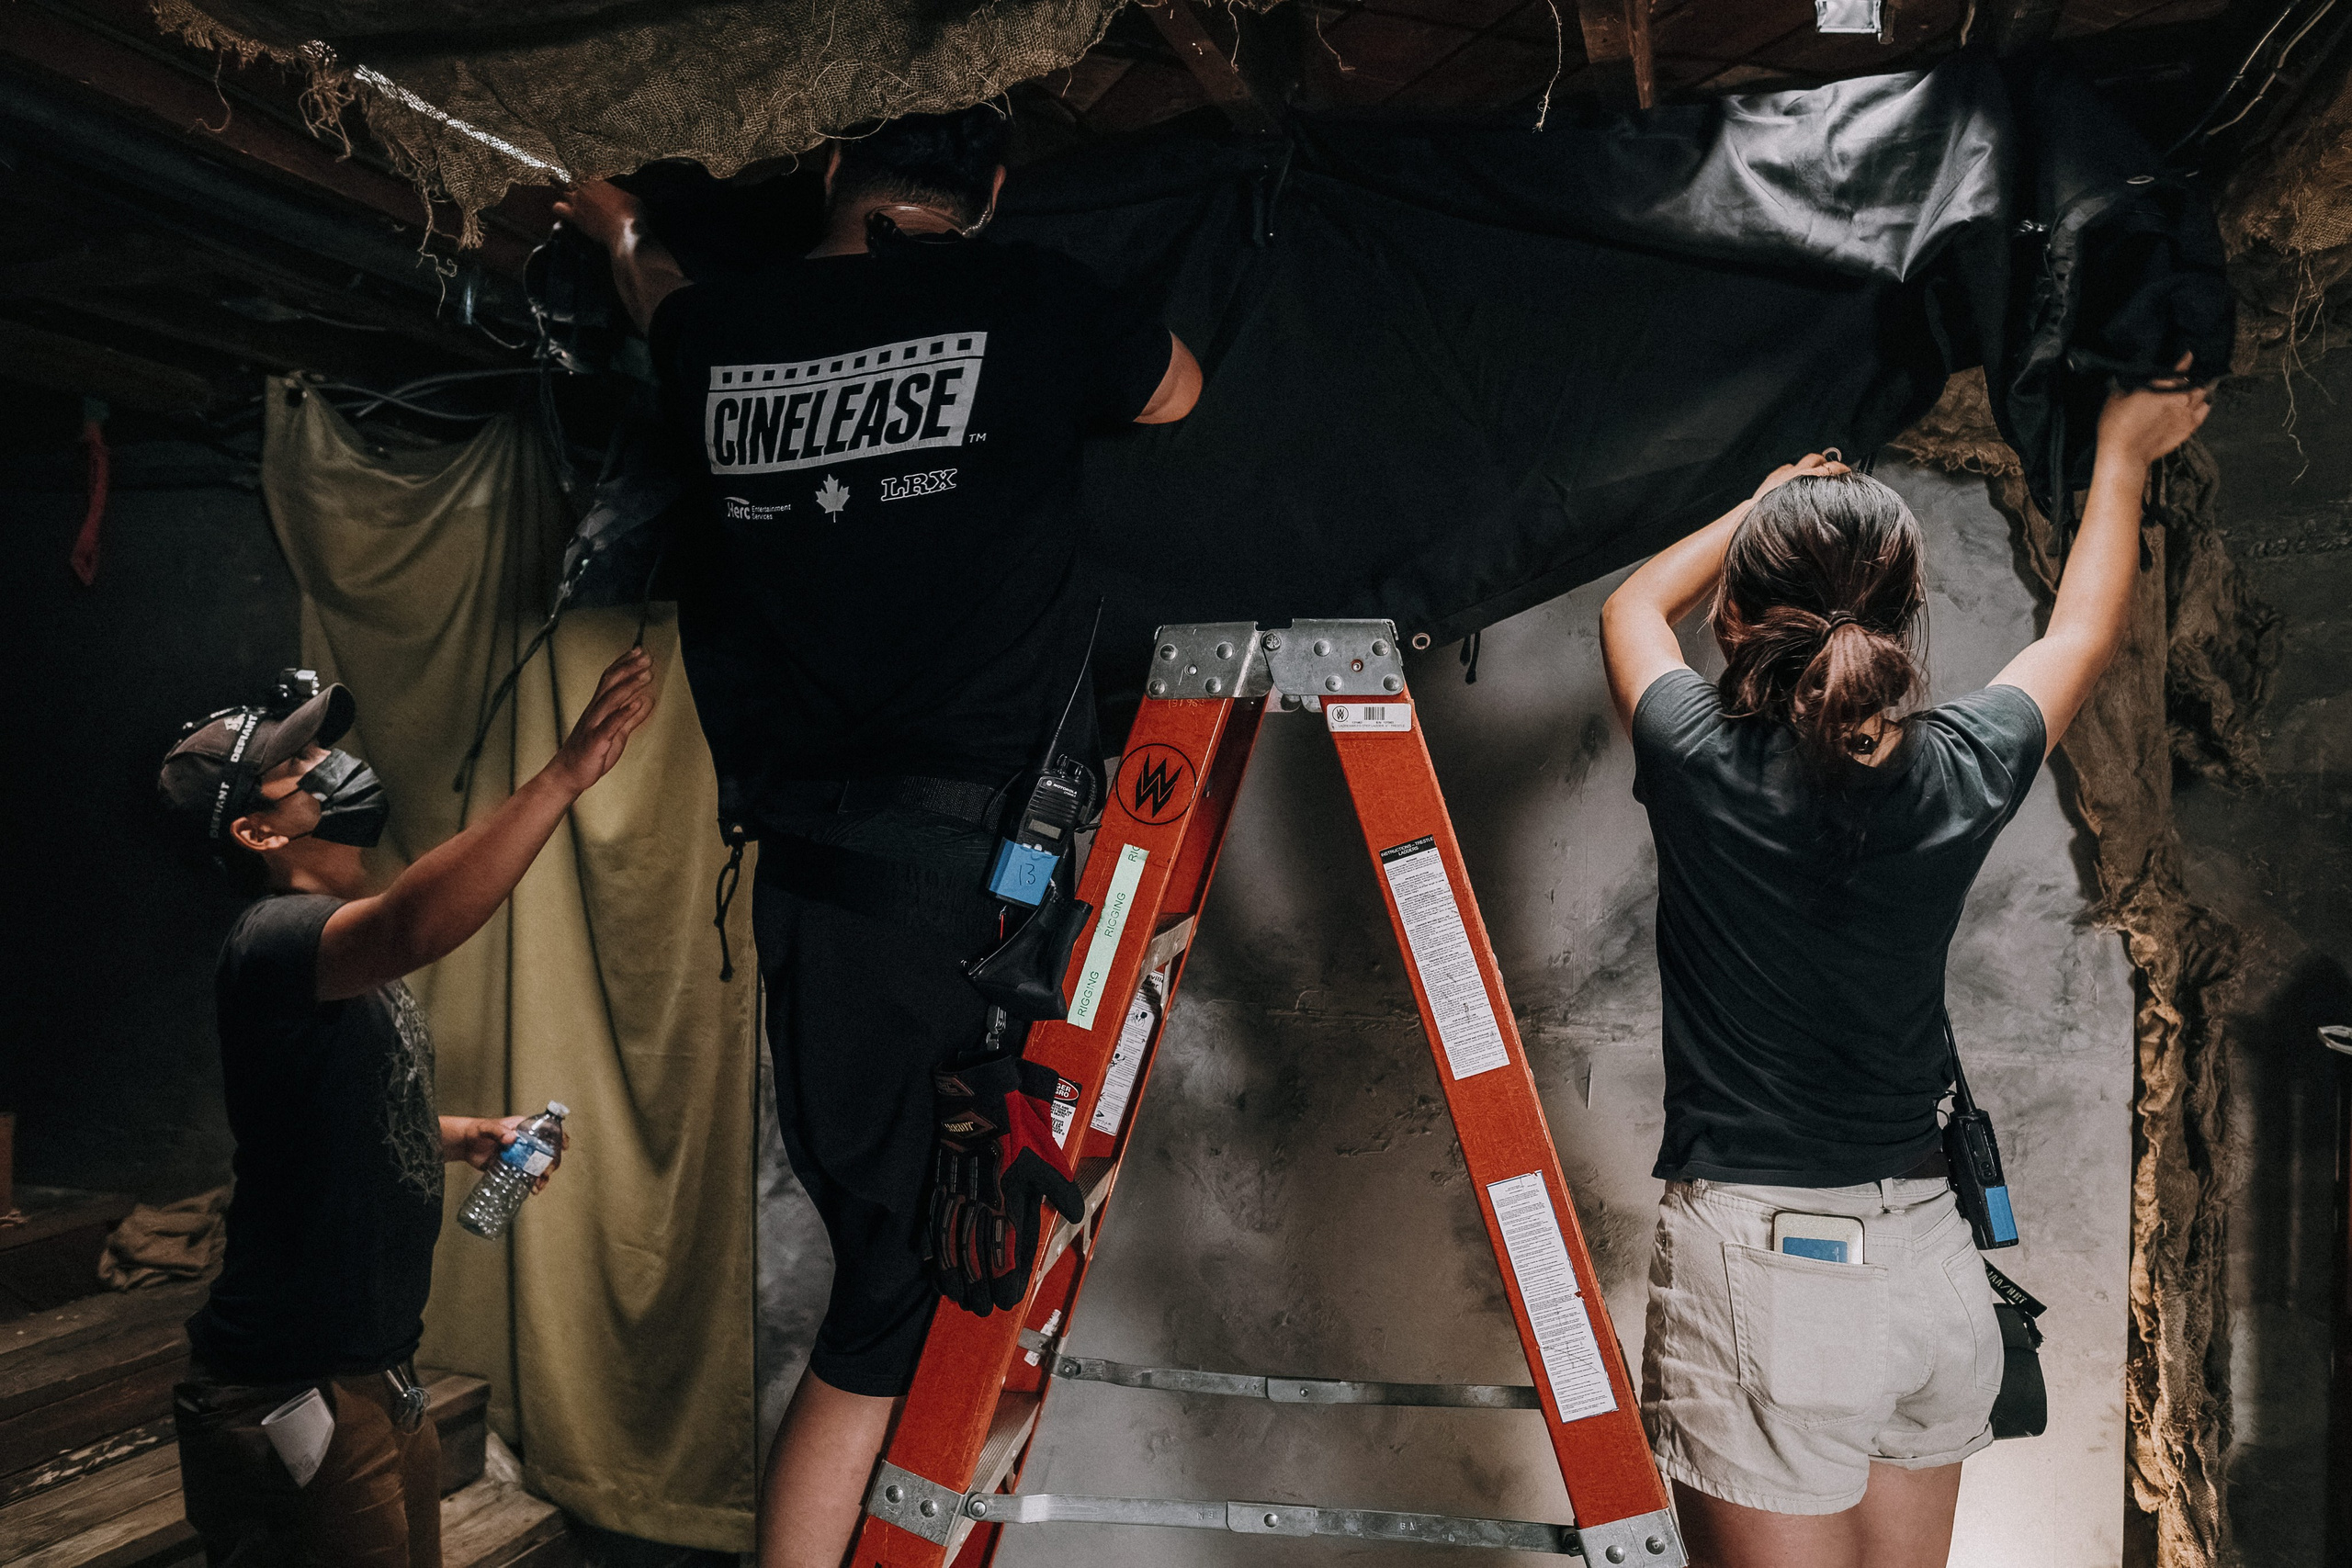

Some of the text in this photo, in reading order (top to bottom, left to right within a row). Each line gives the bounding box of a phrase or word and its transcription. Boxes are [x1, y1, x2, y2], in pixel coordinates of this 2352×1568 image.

[714, 367, 987, 467] CINELEASE TM
[881, 468, 957, 502] LRX
[727, 502, 751, 520] Herc
[752, 504, 791, 513] Entertainment
[231, 714, 258, 762] DEFIANT
[1053, 784, 1077, 795] MOTOROLA
[1380, 844, 1411, 857] INSTRUCTIONS
[1397, 846, 1419, 856] LADDERS
[1019, 863, 1036, 886] 13
[1104, 892, 1126, 938] RIGGING
[1077, 971, 1100, 1017] RIGGING
